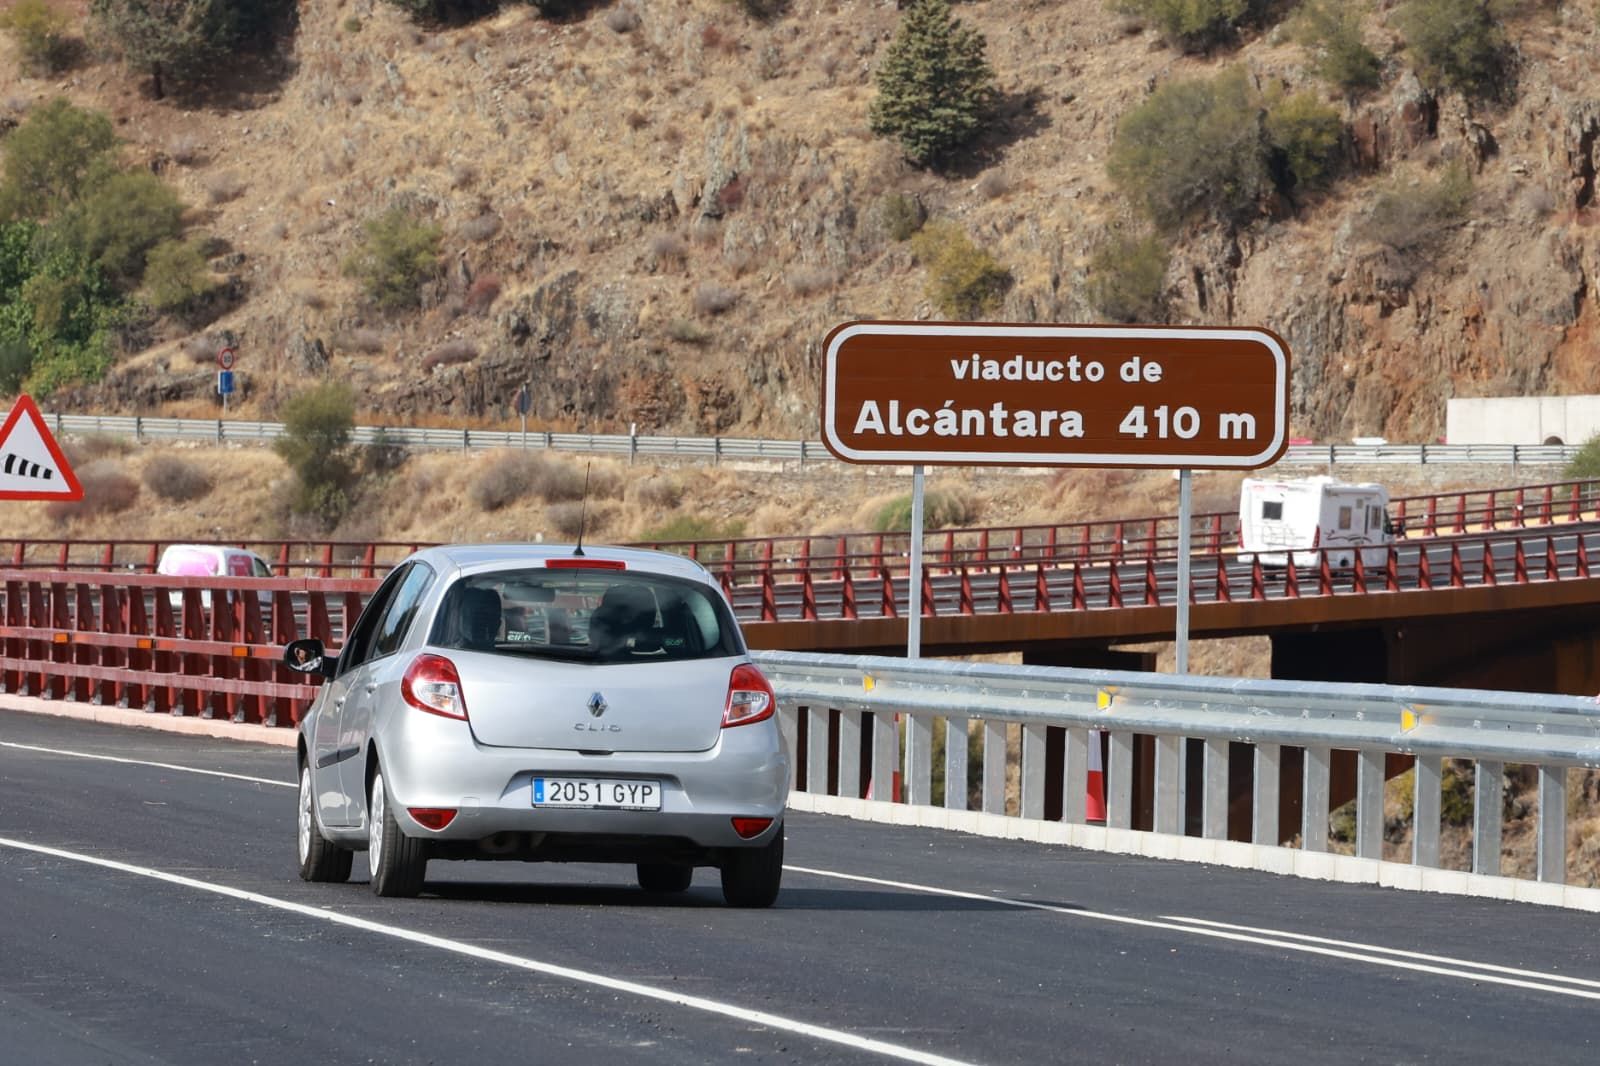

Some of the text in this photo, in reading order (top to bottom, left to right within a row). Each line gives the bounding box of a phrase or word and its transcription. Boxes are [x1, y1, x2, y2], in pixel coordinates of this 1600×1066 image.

[950, 353, 1163, 383] viaducto de
[853, 400, 1257, 440] Alcántara 410 m
[574, 722, 622, 733] CLIO
[549, 782, 602, 802] 2051
[613, 784, 653, 804] GYP
